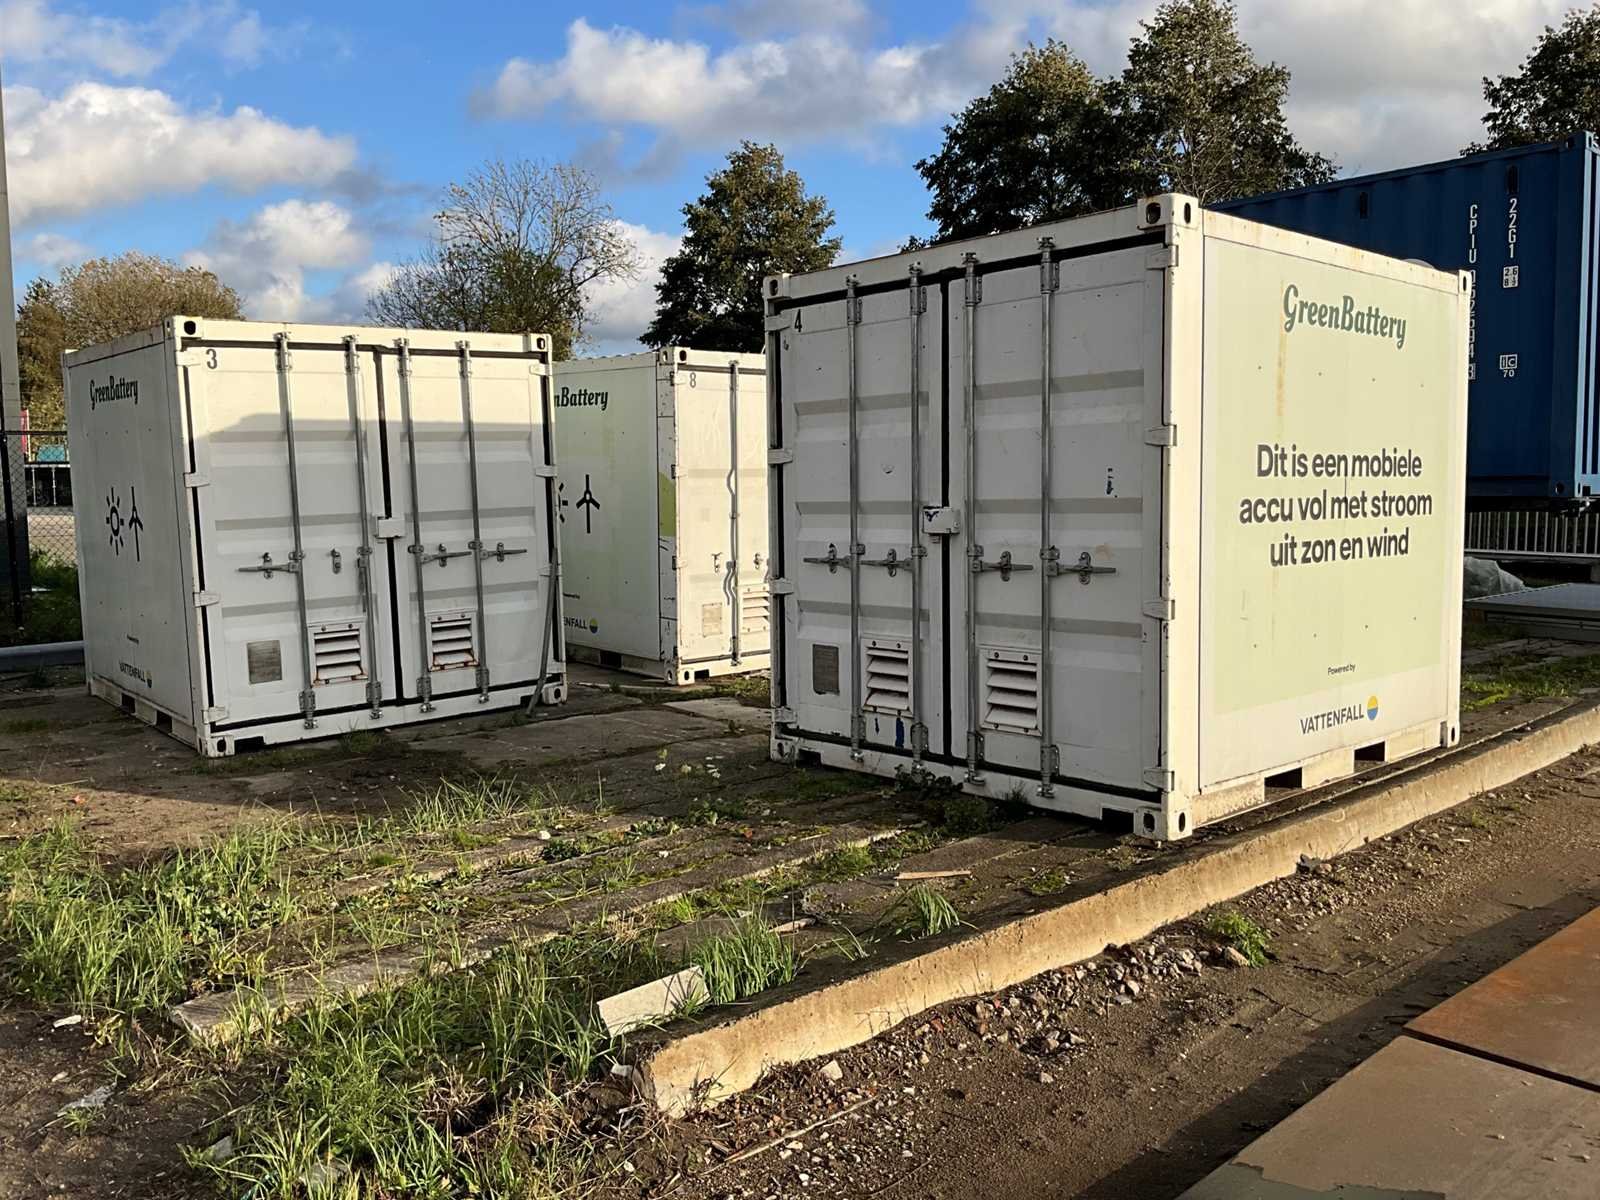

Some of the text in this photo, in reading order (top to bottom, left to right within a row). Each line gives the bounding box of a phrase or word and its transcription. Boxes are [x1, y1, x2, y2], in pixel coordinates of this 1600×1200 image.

[1469, 204, 1478, 264] CPIU
[1508, 198, 1518, 259] 22G1
[794, 309, 803, 333] 4
[1283, 284, 1407, 350] GreenBattery
[206, 348, 218, 370] 3
[1503, 369, 1515, 378] 70
[89, 375, 138, 410] GreenBattery
[689, 372, 697, 388] 8
[554, 386, 609, 411] nBattery
[1257, 443, 1422, 477] Dit is een mobiele
[1239, 489, 1432, 524] accu vol met stroom
[1270, 527, 1409, 567] uit zon en wind
[563, 616, 588, 630] ENFALL
[1300, 703, 1364, 735] VATTENFALL
